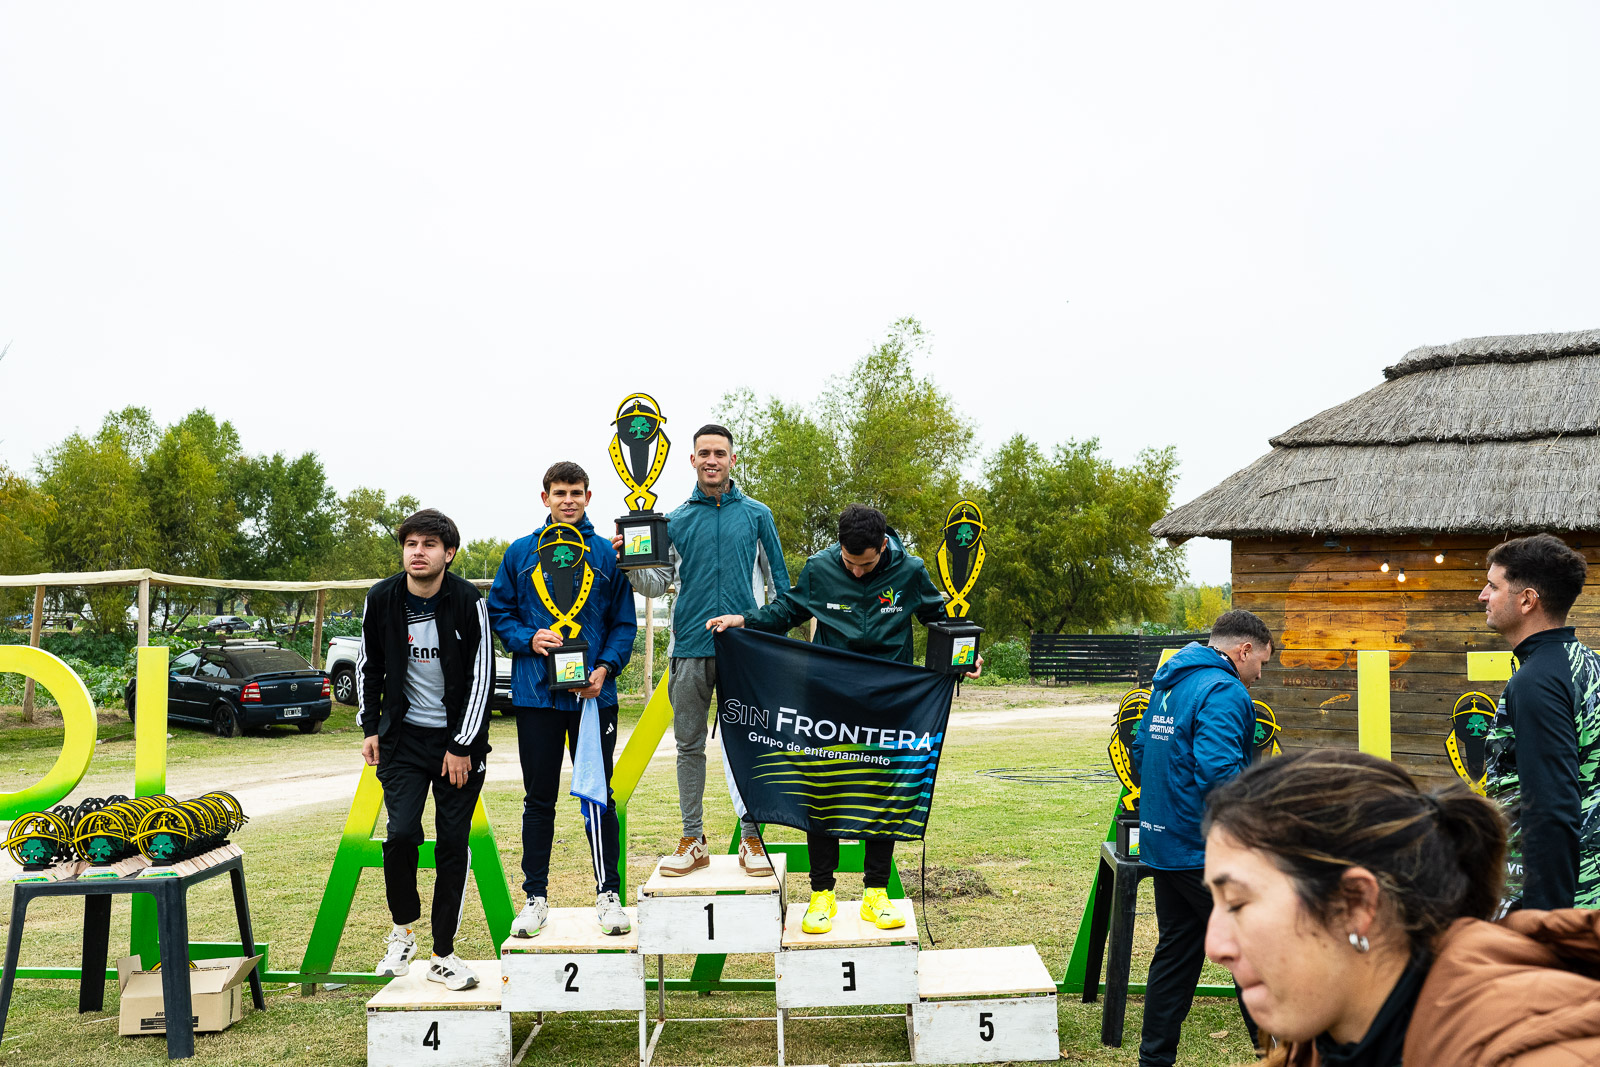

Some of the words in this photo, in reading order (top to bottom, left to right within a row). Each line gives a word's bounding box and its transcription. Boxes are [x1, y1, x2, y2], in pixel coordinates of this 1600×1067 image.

[632, 535, 642, 553] 1
[958, 644, 970, 664] 3
[564, 661, 577, 680] 2
[722, 698, 770, 729] SIN
[776, 706, 932, 752] FRONTERA
[748, 732, 784, 749] Grupo
[786, 741, 801, 753] de
[803, 746, 891, 766] entrenamiento
[704, 902, 715, 941] 1
[565, 962, 580, 993] 2
[841, 961, 857, 992] 3
[422, 1021, 441, 1051] 4
[979, 1012, 994, 1042] 5
